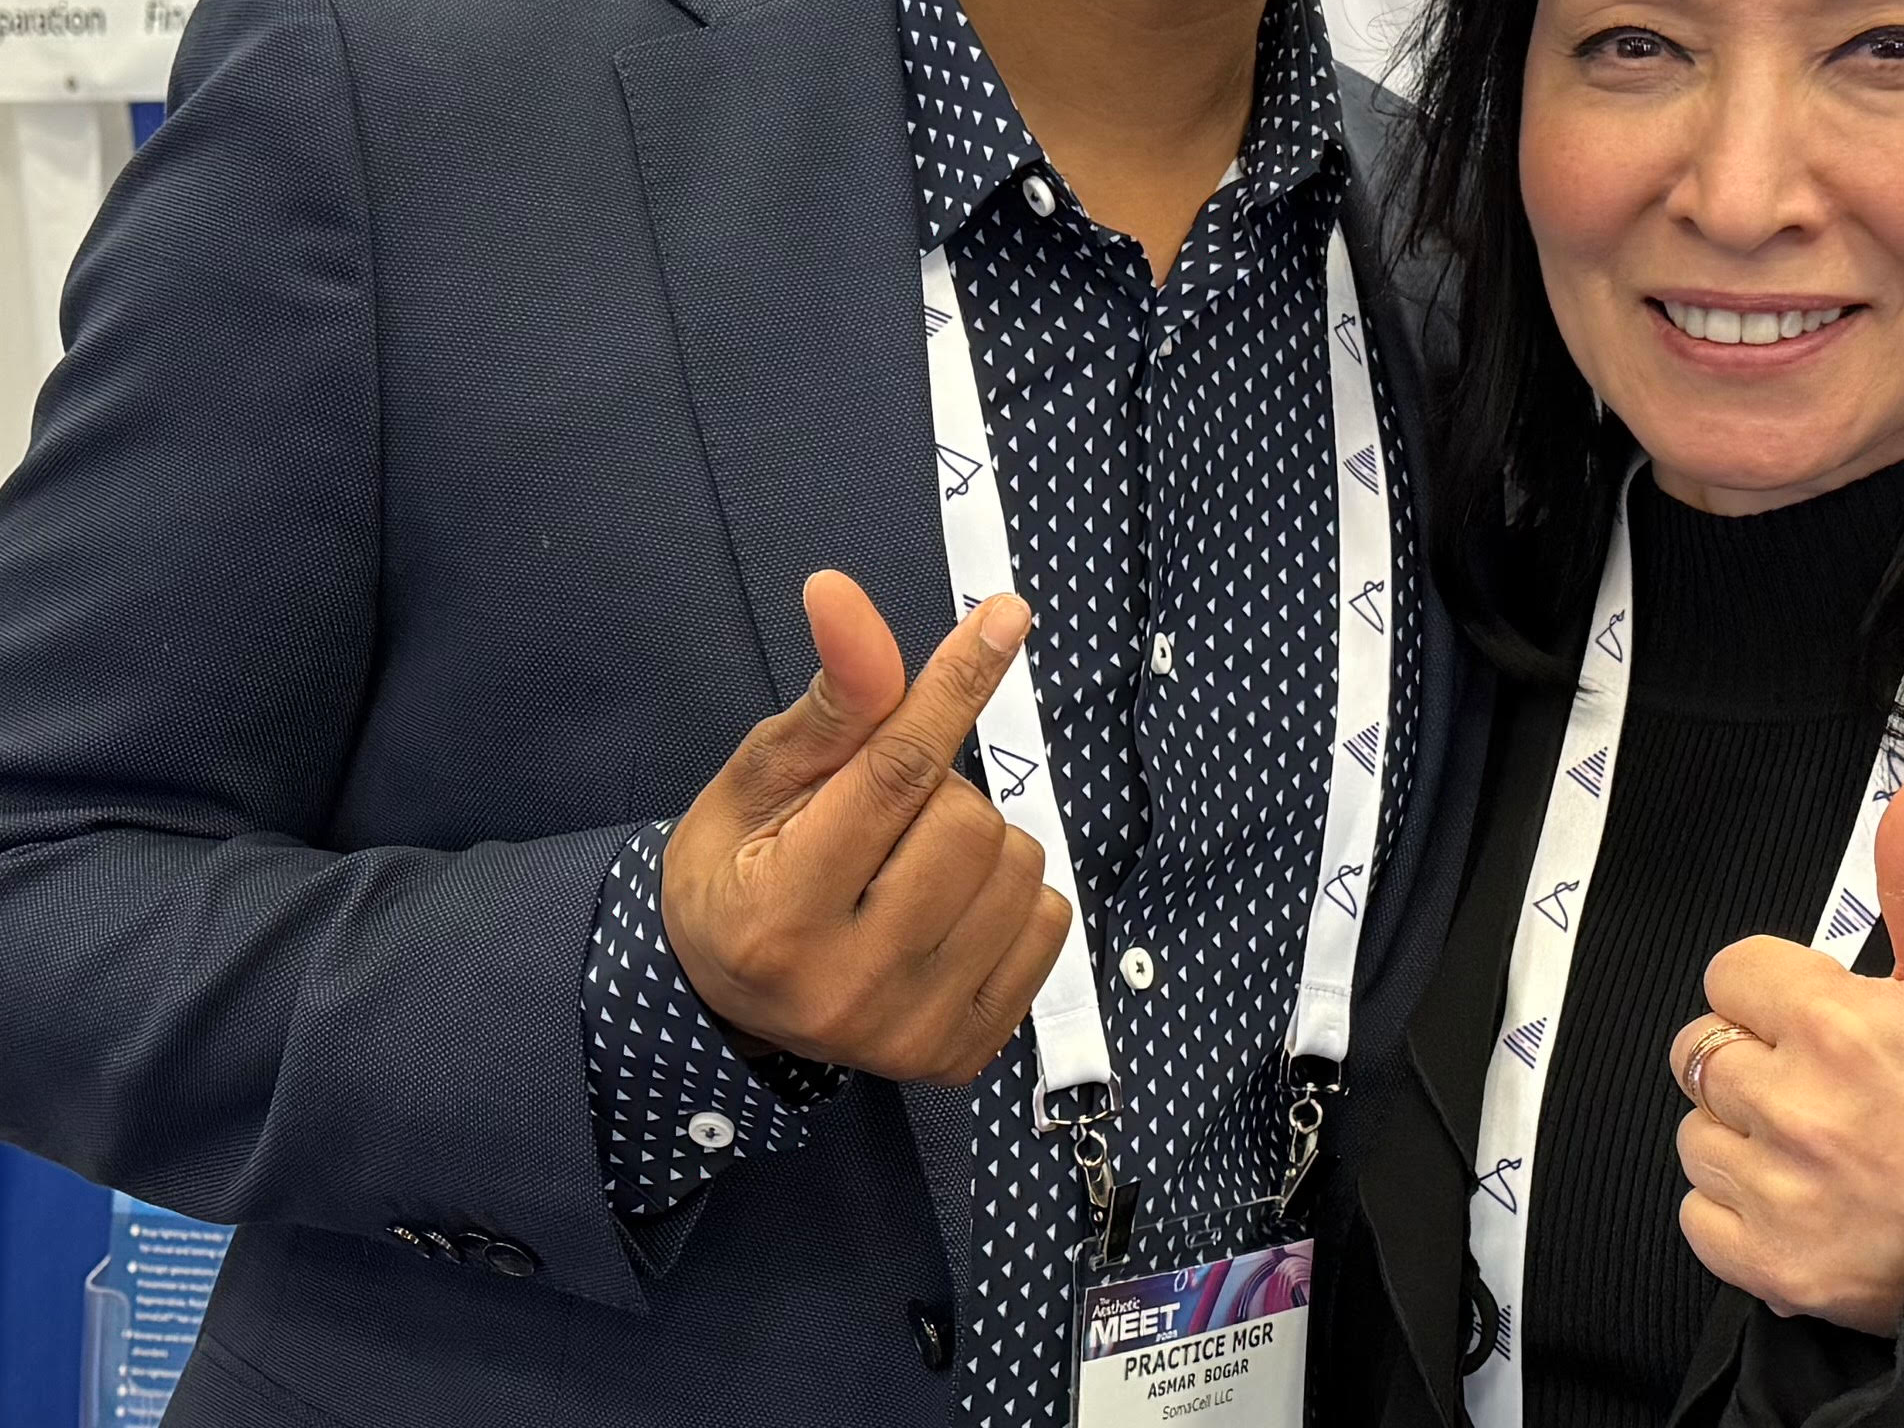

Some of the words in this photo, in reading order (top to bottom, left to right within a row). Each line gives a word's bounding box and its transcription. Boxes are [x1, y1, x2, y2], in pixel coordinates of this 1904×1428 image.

[1089, 1302, 1181, 1348] MEET
[1091, 1296, 1141, 1319] Aesthetic
[1124, 1333, 1226, 1381] PRACTICE
[1232, 1322, 1274, 1353] MGR
[1147, 1372, 1196, 1400] ASMAR
[1204, 1358, 1249, 1384] BOGAR
[1162, 1394, 1211, 1420] SomaCell
[1214, 1388, 1234, 1406] LLC
